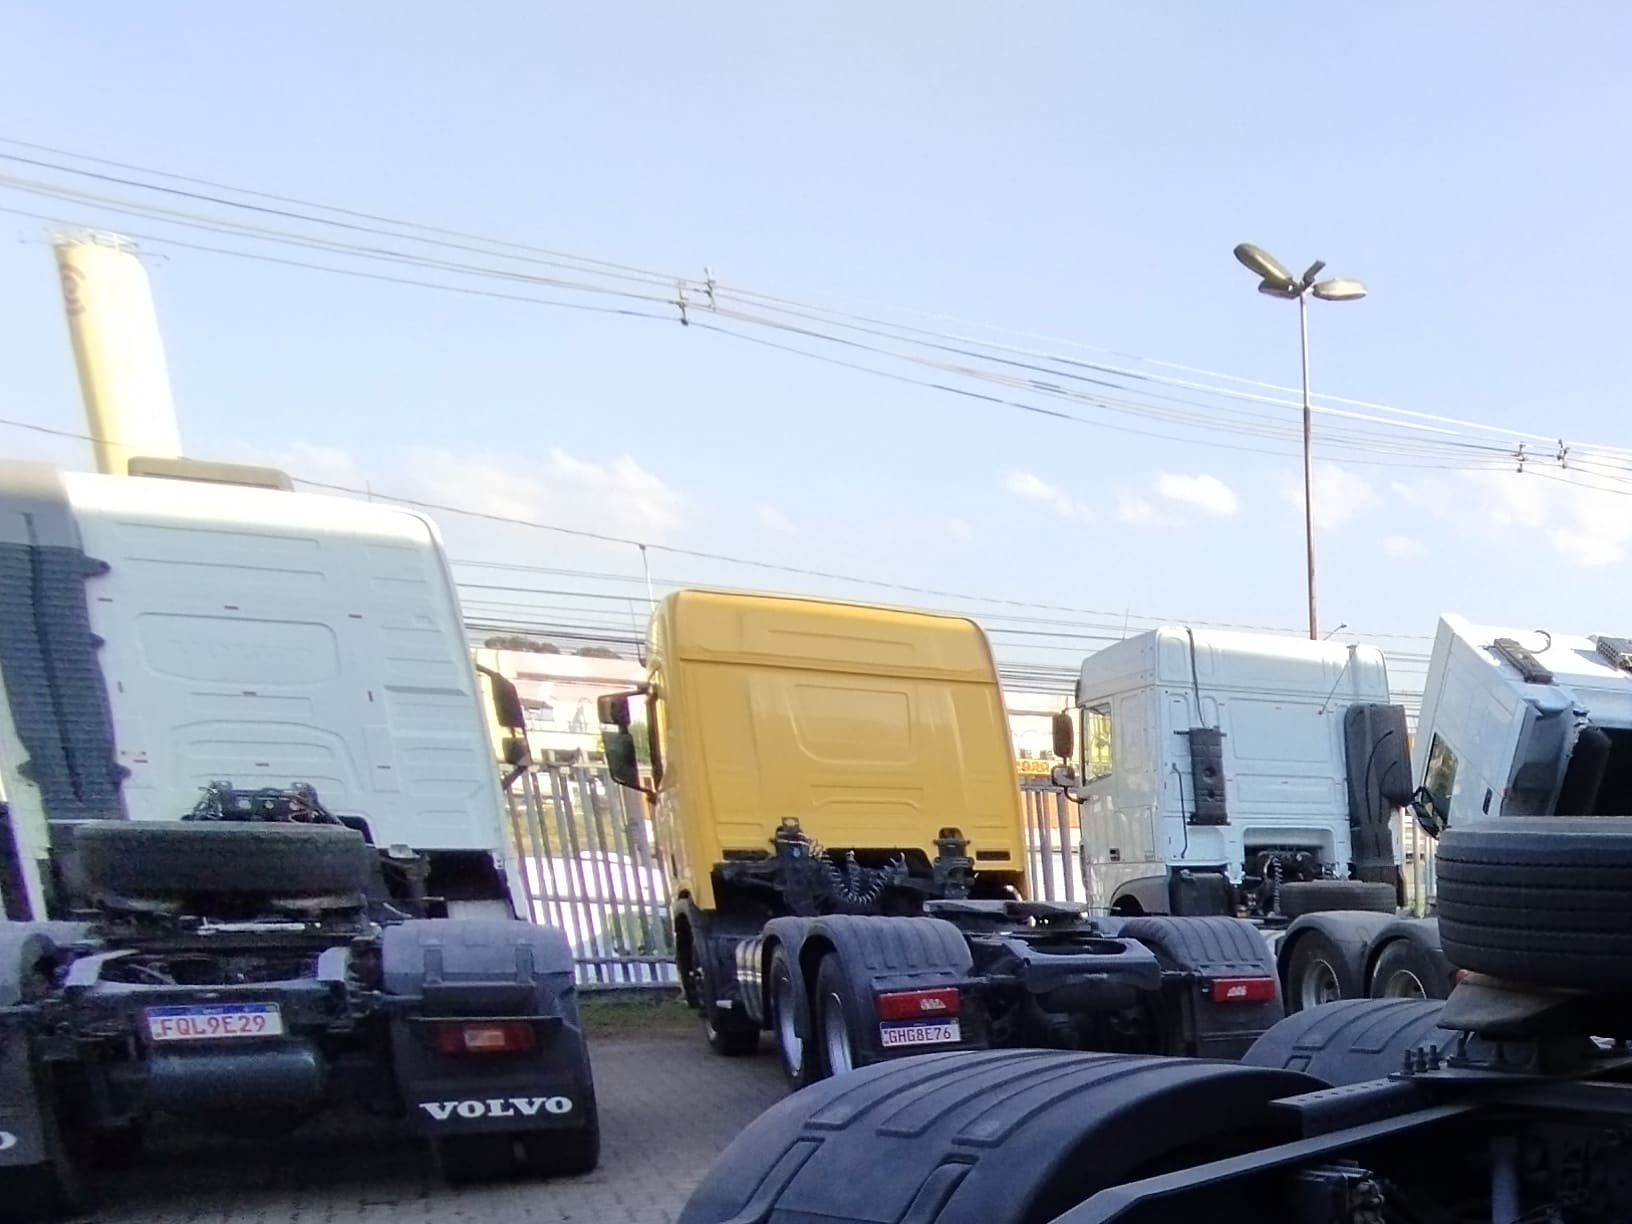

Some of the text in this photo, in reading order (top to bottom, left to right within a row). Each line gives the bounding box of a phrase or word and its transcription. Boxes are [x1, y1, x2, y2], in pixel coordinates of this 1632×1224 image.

[160, 1015, 266, 1036] FQL9E29
[888, 1027, 952, 1044] GHG8E76
[418, 1096, 573, 1121] VOLVO
